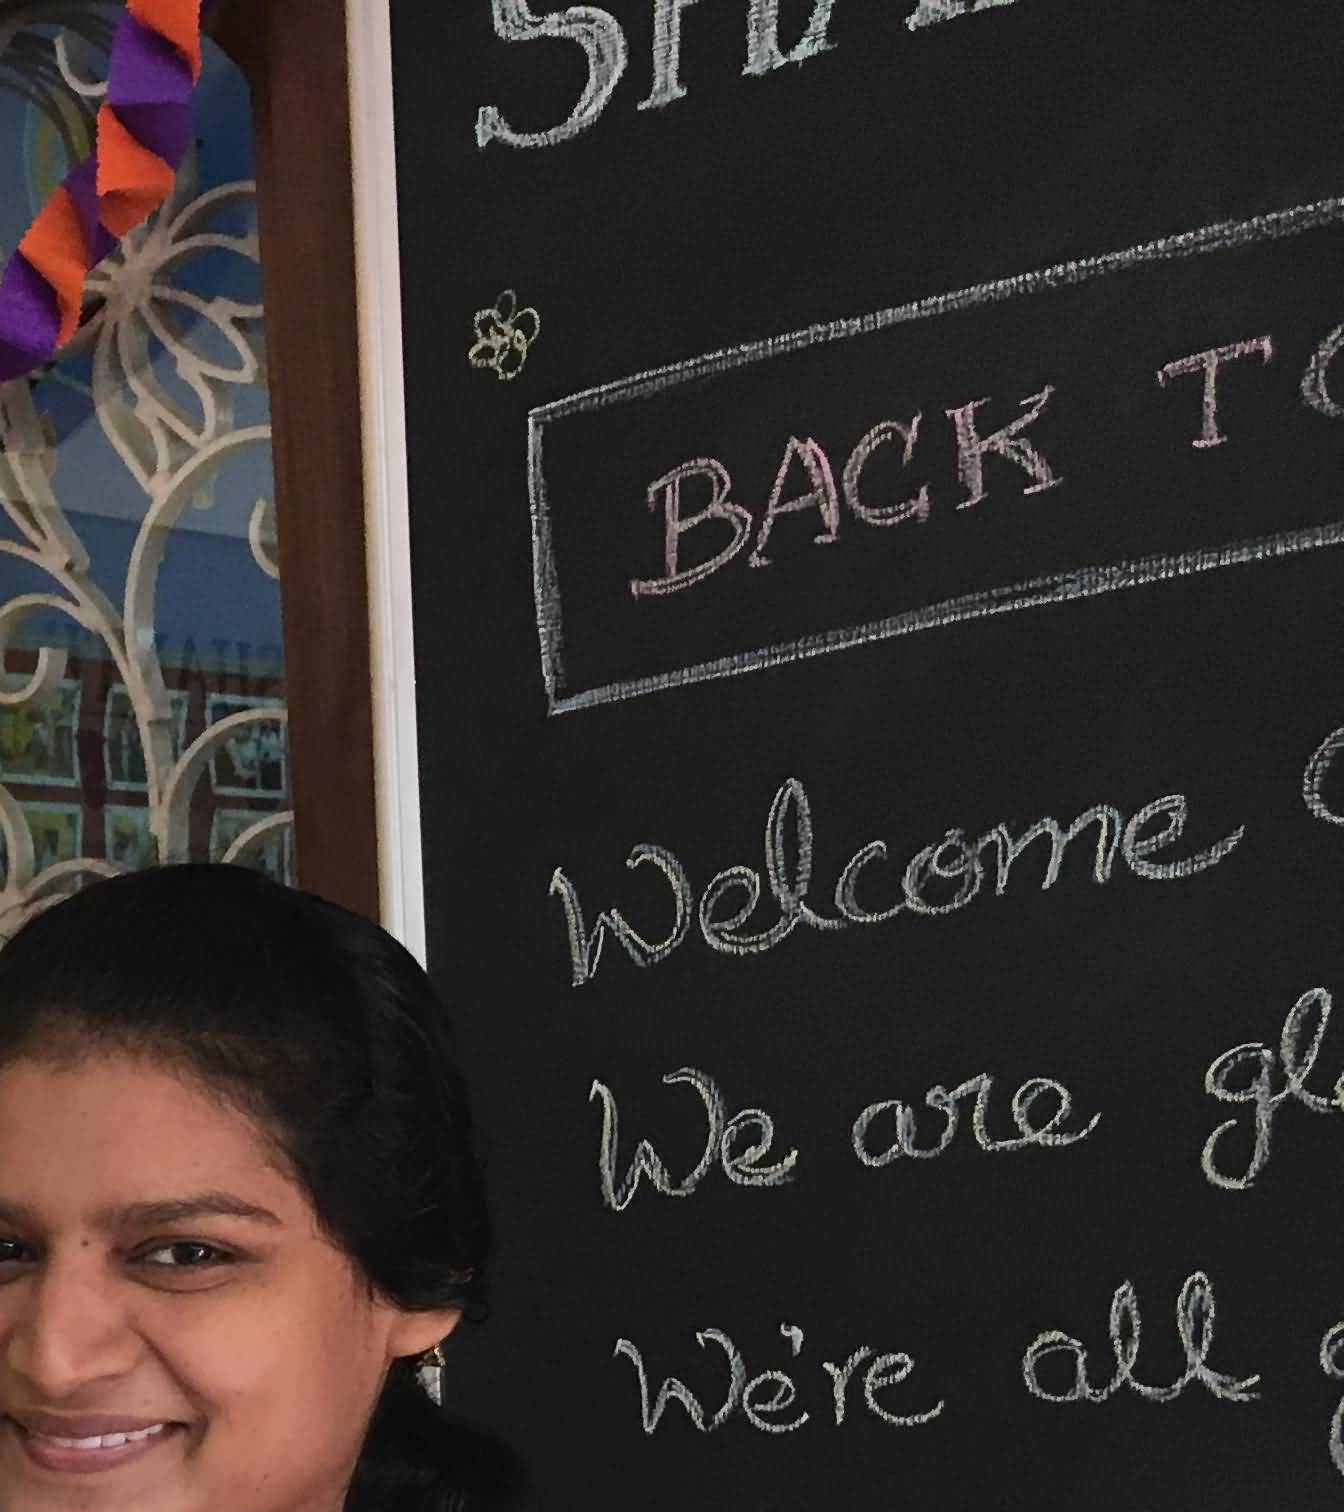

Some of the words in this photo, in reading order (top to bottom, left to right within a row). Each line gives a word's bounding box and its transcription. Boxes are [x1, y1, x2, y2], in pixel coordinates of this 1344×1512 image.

[632, 386, 1062, 600] BACK
[549, 778, 1244, 986] Welcome
[590, 1066, 798, 1210] We
[852, 1073, 1101, 1166] are
[1201, 988, 1344, 1189] gl
[615, 1323, 944, 1434] We're
[1023, 1271, 1261, 1402] all
